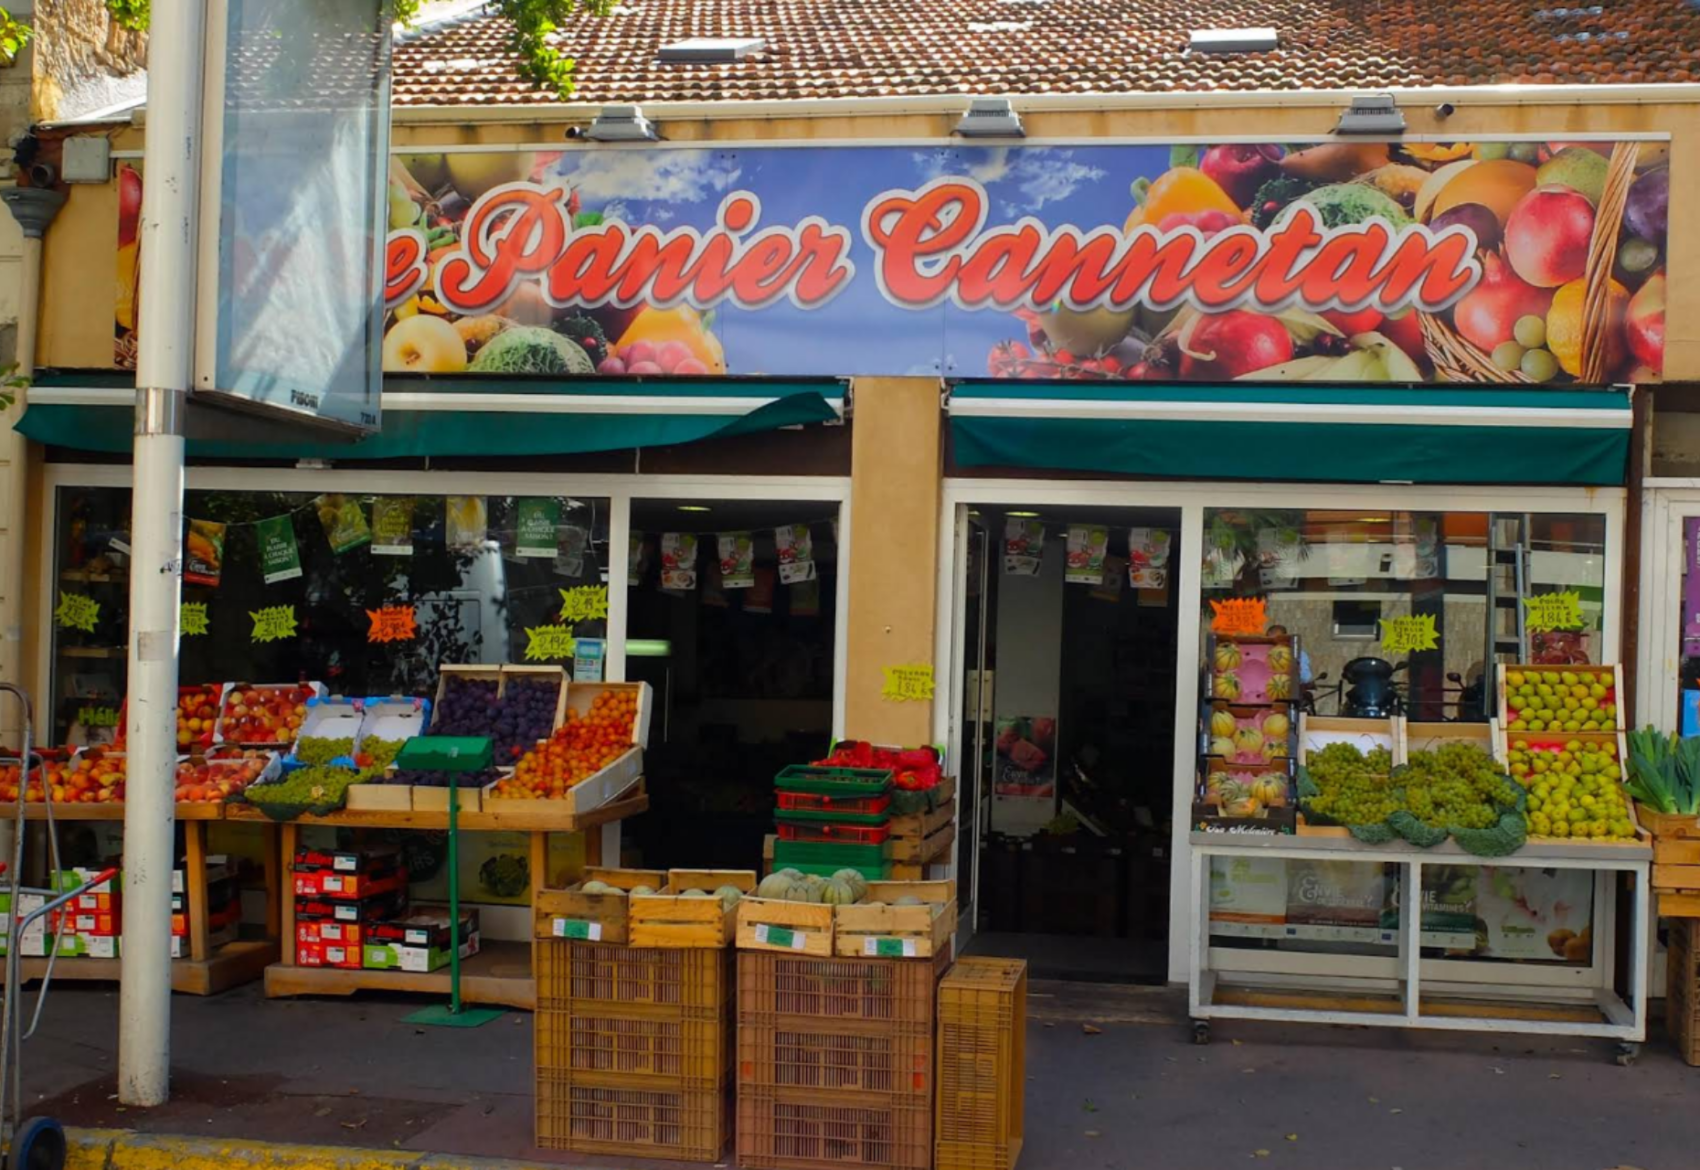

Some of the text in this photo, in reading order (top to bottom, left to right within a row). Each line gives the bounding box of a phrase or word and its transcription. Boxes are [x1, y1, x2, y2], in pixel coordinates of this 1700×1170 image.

[384, 183, 1473, 309] e Panier Cannetan
